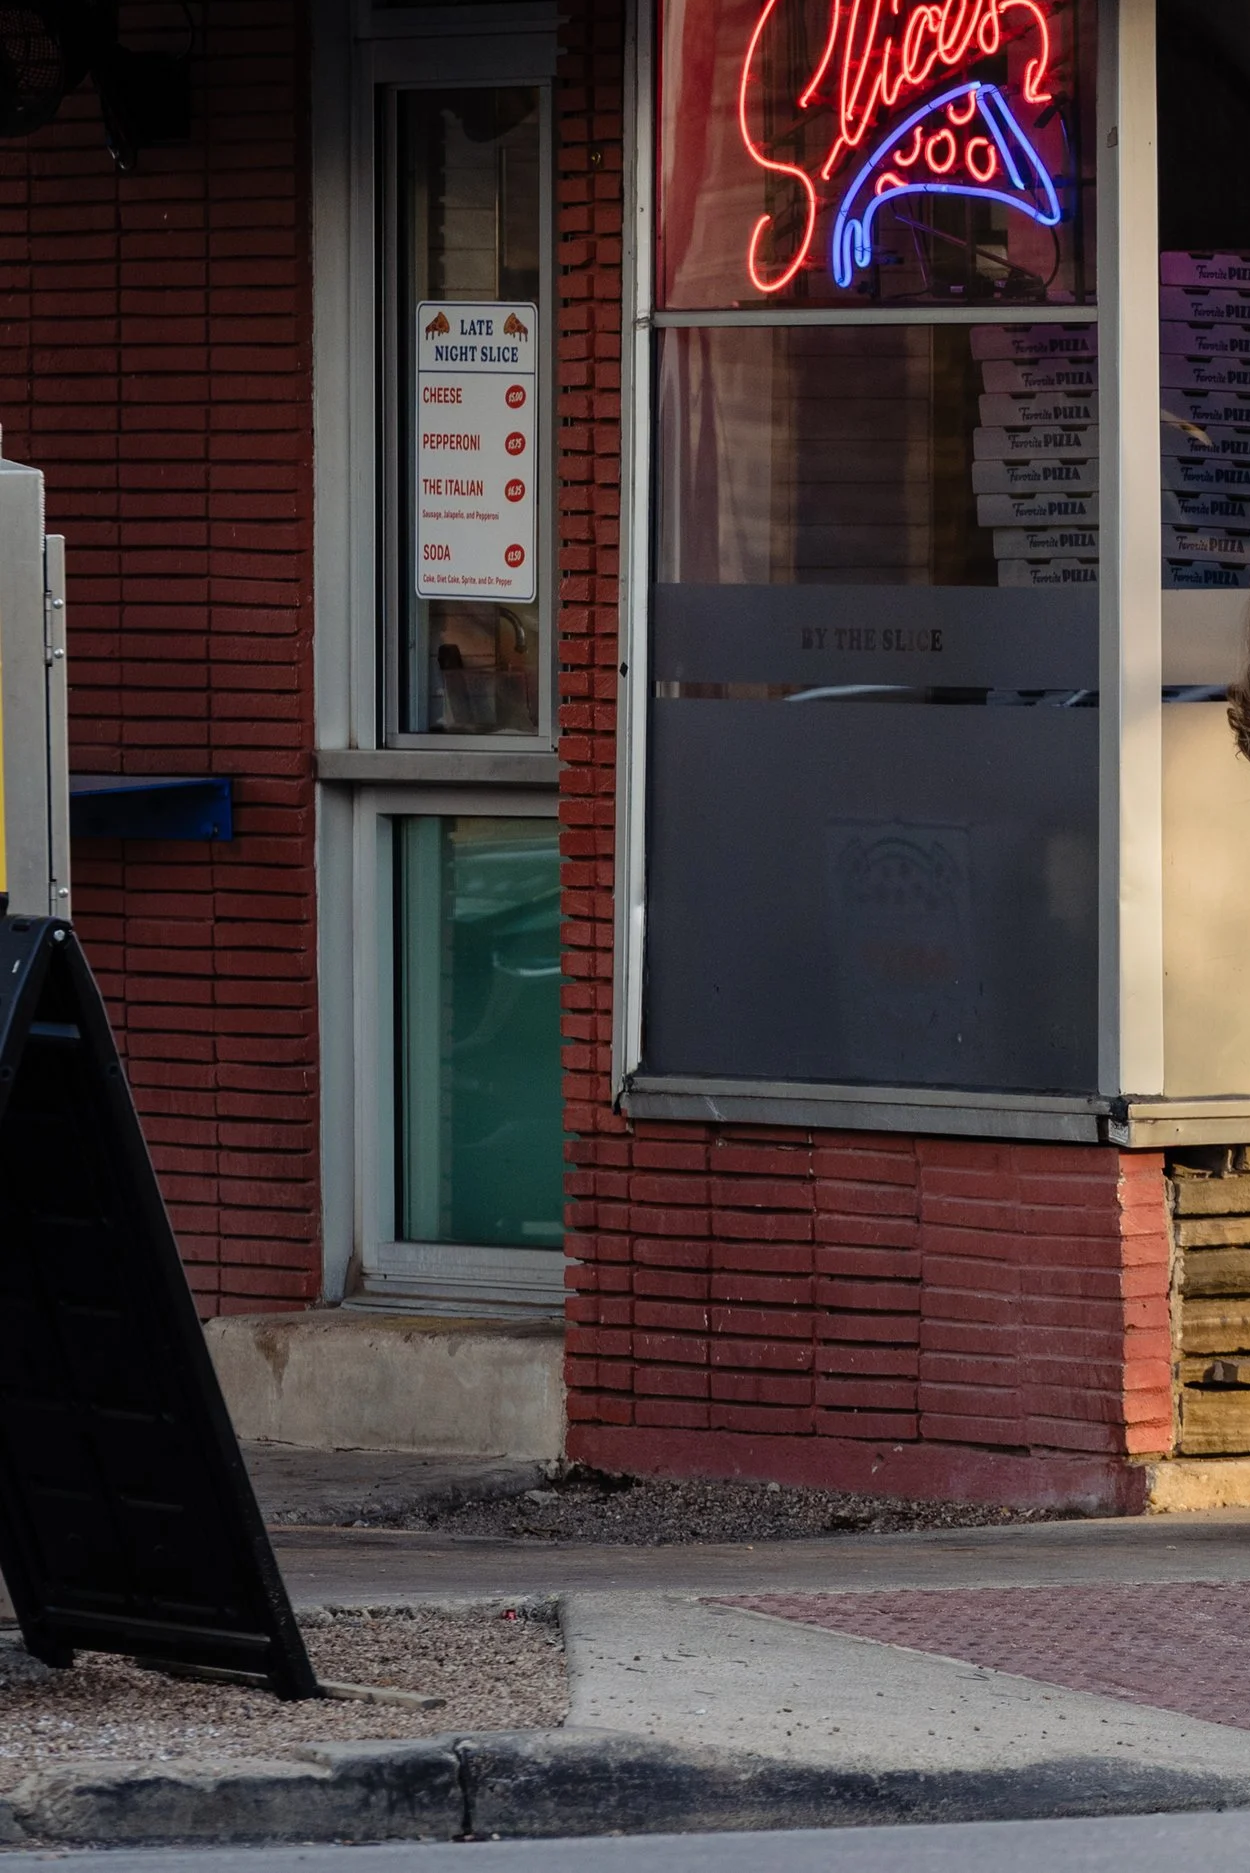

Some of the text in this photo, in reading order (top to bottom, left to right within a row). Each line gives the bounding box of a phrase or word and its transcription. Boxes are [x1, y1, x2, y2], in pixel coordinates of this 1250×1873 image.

[460, 319, 493, 336] LATE
[1048, 338, 1089, 352] PIZZA
[435, 345, 519, 363] NIGHT SLICE
[1056, 371, 1093, 385] PIZZA
[423, 387, 462, 404] CHEESE
[1053, 406, 1091, 419] PIZZA
[423, 434, 480, 450] PEPPERONI
[1043, 433, 1082, 447] PIZZA
[1042, 467, 1080, 481] PIZZA
[423, 479, 442, 495] THE
[445, 479, 483, 496] ITALIAN
[1048, 502, 1087, 516] PIZZA
[1210, 500, 1246, 517] PIZZA
[466, 511, 474, 519] and
[476, 511, 499, 522] Pepperoni
[1060, 533, 1096, 547] PIZZA
[1209, 537, 1245, 554] PIZZA
[423, 544, 450, 560] SODA
[478, 577, 486, 585] and
[495, 578, 512, 587] Pepper
[1062, 569, 1097, 582] PIZZA
[1203, 570, 1239, 586] PIZZA
[801, 628, 943, 651] BY THE SLICE
